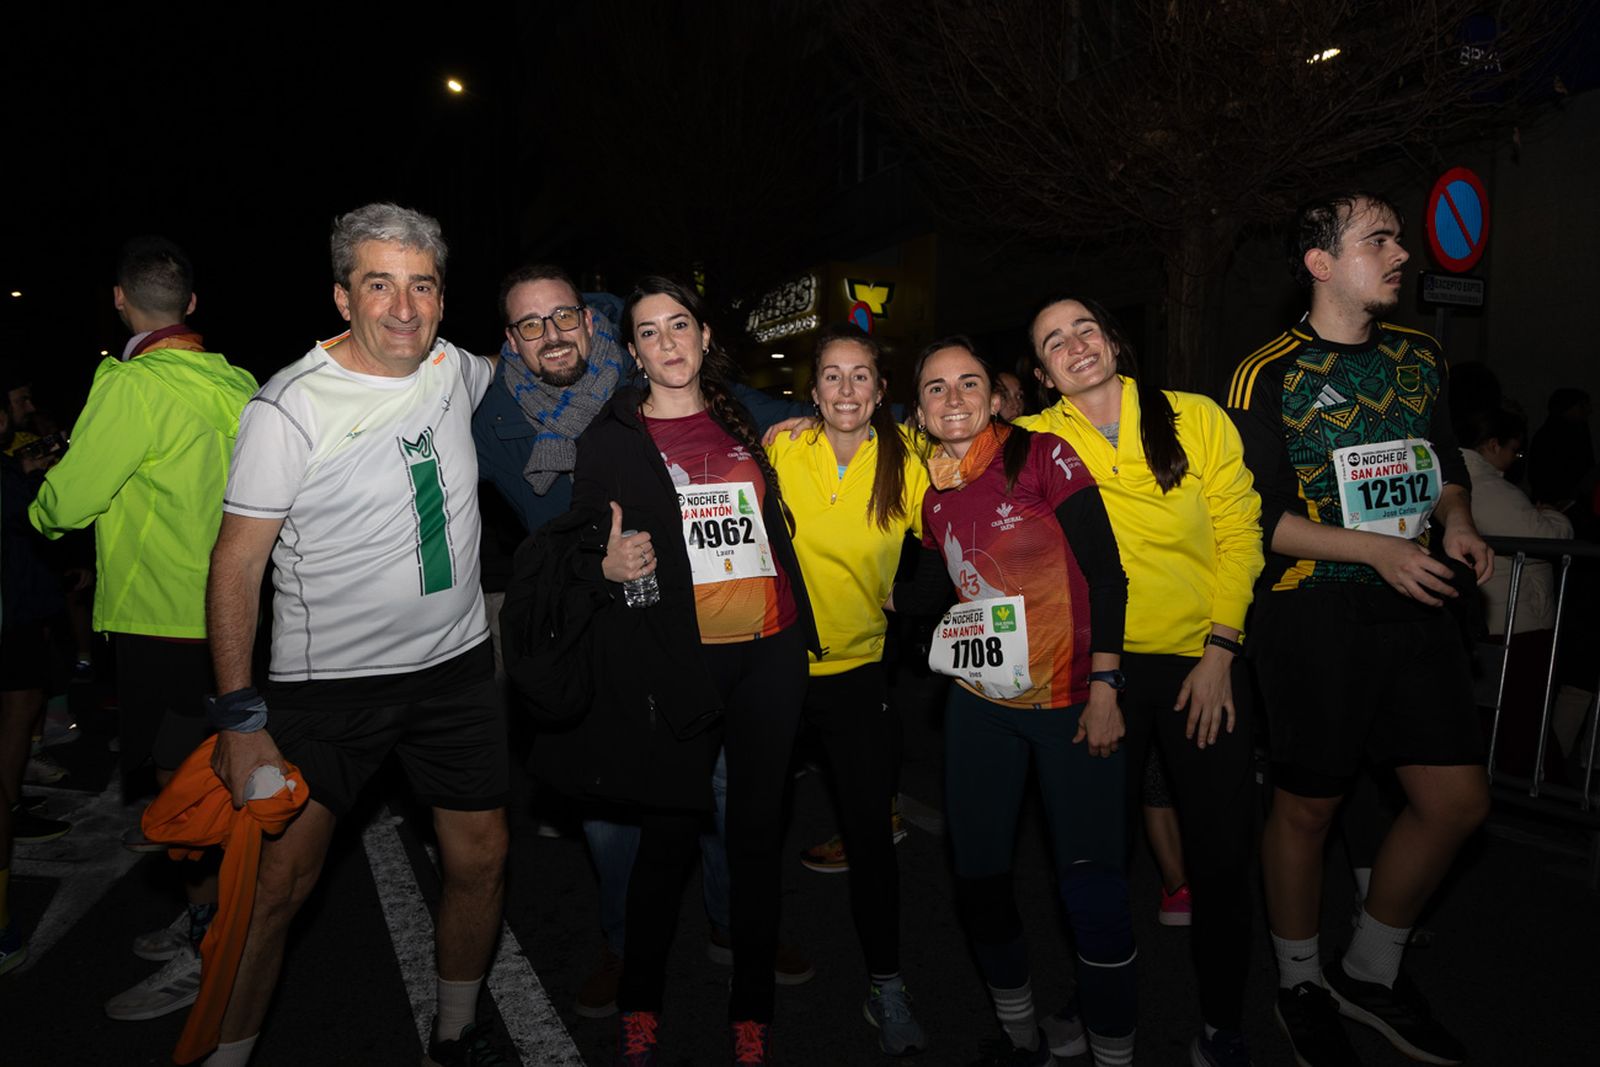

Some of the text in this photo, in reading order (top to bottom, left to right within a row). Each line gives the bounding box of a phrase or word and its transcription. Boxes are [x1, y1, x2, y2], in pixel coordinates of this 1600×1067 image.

[1362, 453, 1394, 465] NOCHE
[1396, 451, 1408, 461] DE
[1351, 467, 1373, 480] SAN
[1375, 462, 1409, 476] ANTÓN
[1358, 473, 1431, 510] 12512
[687, 495, 717, 506] NOCHE
[718, 494, 730, 504] DE
[682, 509, 698, 520] AN
[699, 504, 732, 518] ANTÓN
[689, 517, 755, 549] 4962
[716, 549, 735, 557] Laura
[960, 570, 980, 596] 43
[952, 614, 974, 625] NOCHE
[974, 612, 984, 622] DE
[942, 627, 958, 639] SAN
[951, 636, 1004, 669] 1708
